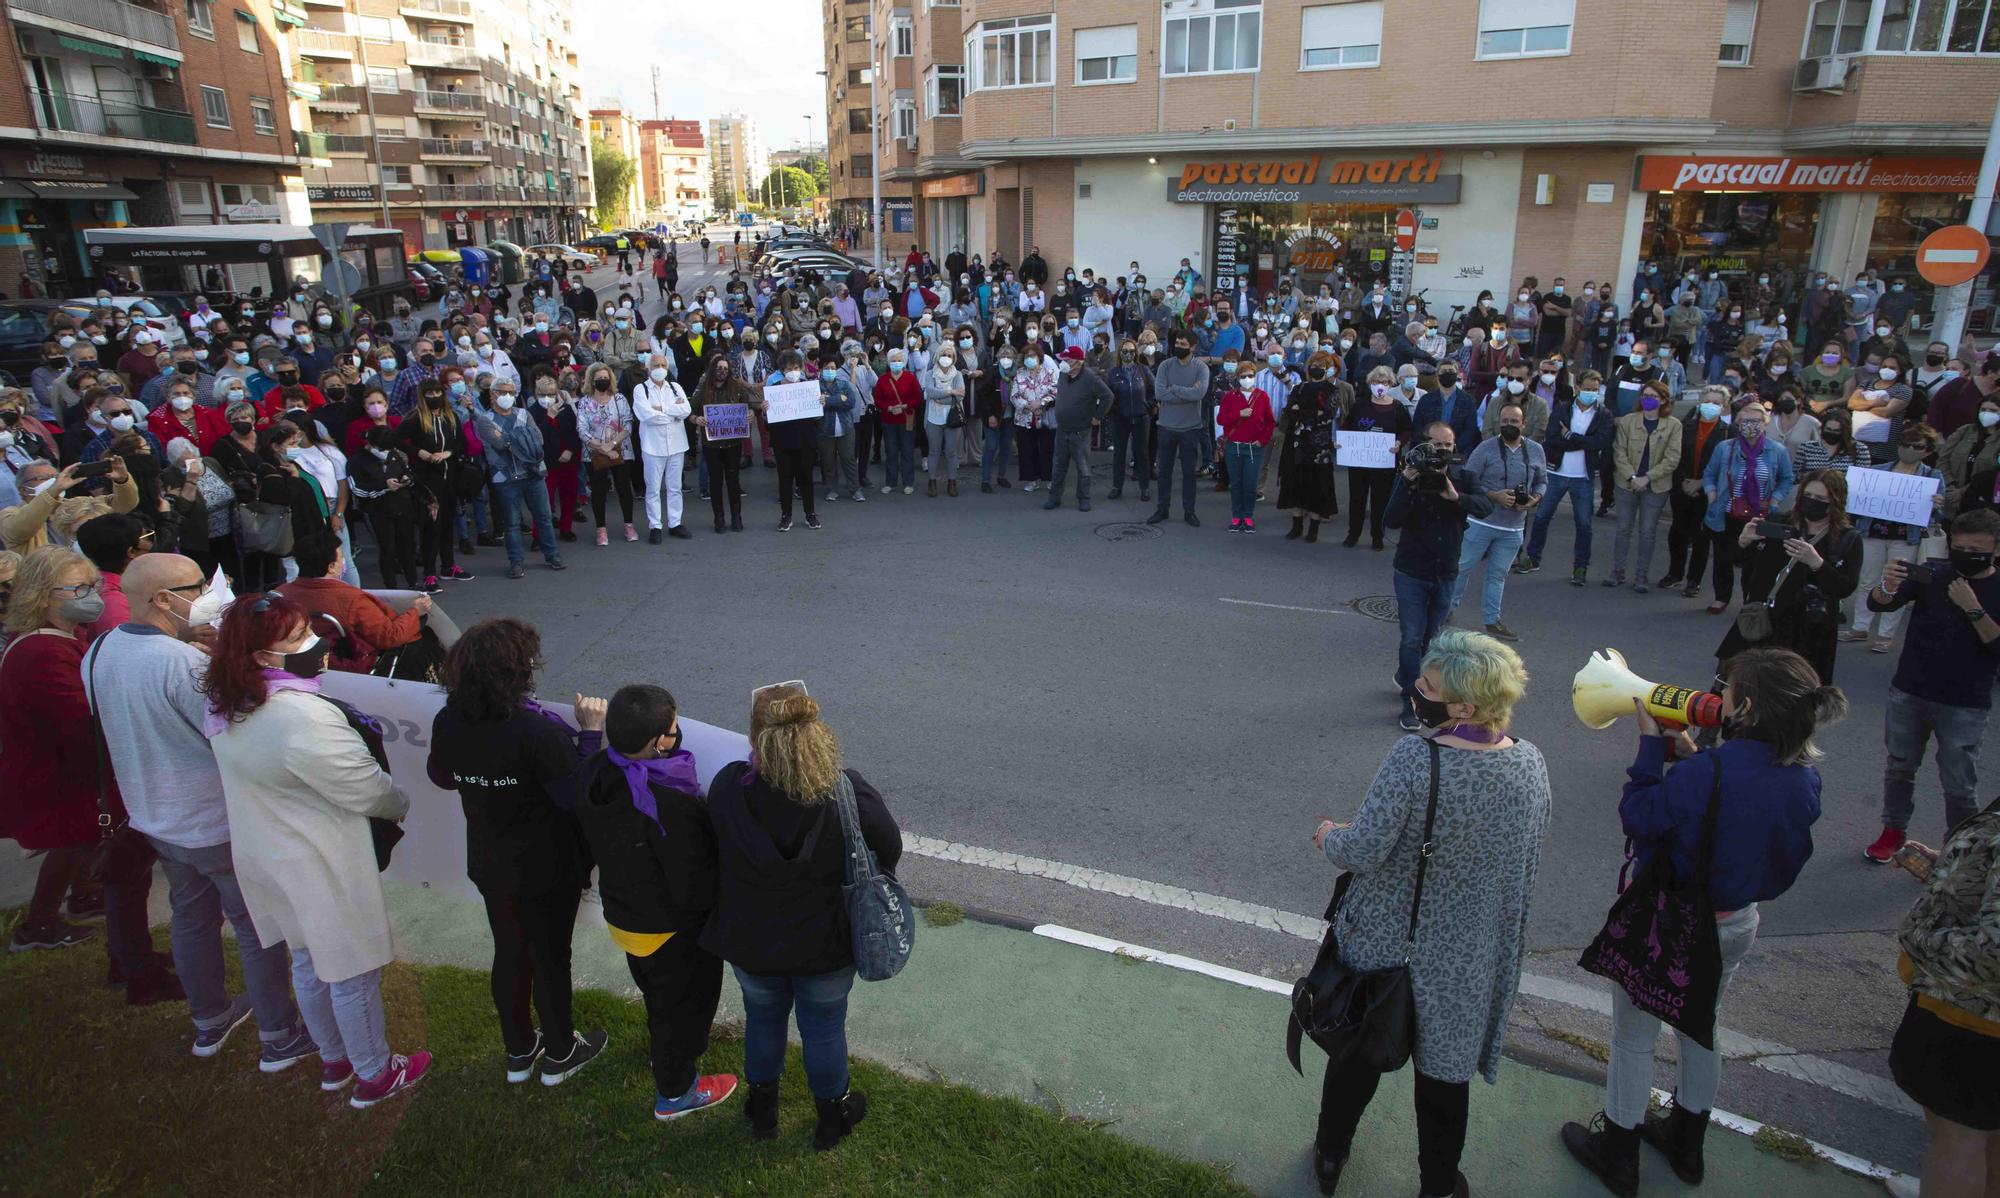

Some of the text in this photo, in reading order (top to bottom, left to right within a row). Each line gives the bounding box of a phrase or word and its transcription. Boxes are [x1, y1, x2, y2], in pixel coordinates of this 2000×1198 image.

[1179, 153, 1321, 190] pascual
[1673, 159, 1791, 190] pascual
[1870, 171, 1979, 187] electrodoméstic
[1177, 188, 1300, 202] electrodomésticos
[707, 406, 720, 417] ES
[708, 427, 718, 437] NI
[720, 427, 733, 436] UNA
[1347, 436, 1389, 449] NI UNA
[1350, 448, 1389, 463] MENOS
[1858, 471, 1924, 500] NI UNA
[1854, 495, 1916, 519] MENOS
[493, 776, 518, 787] sola
